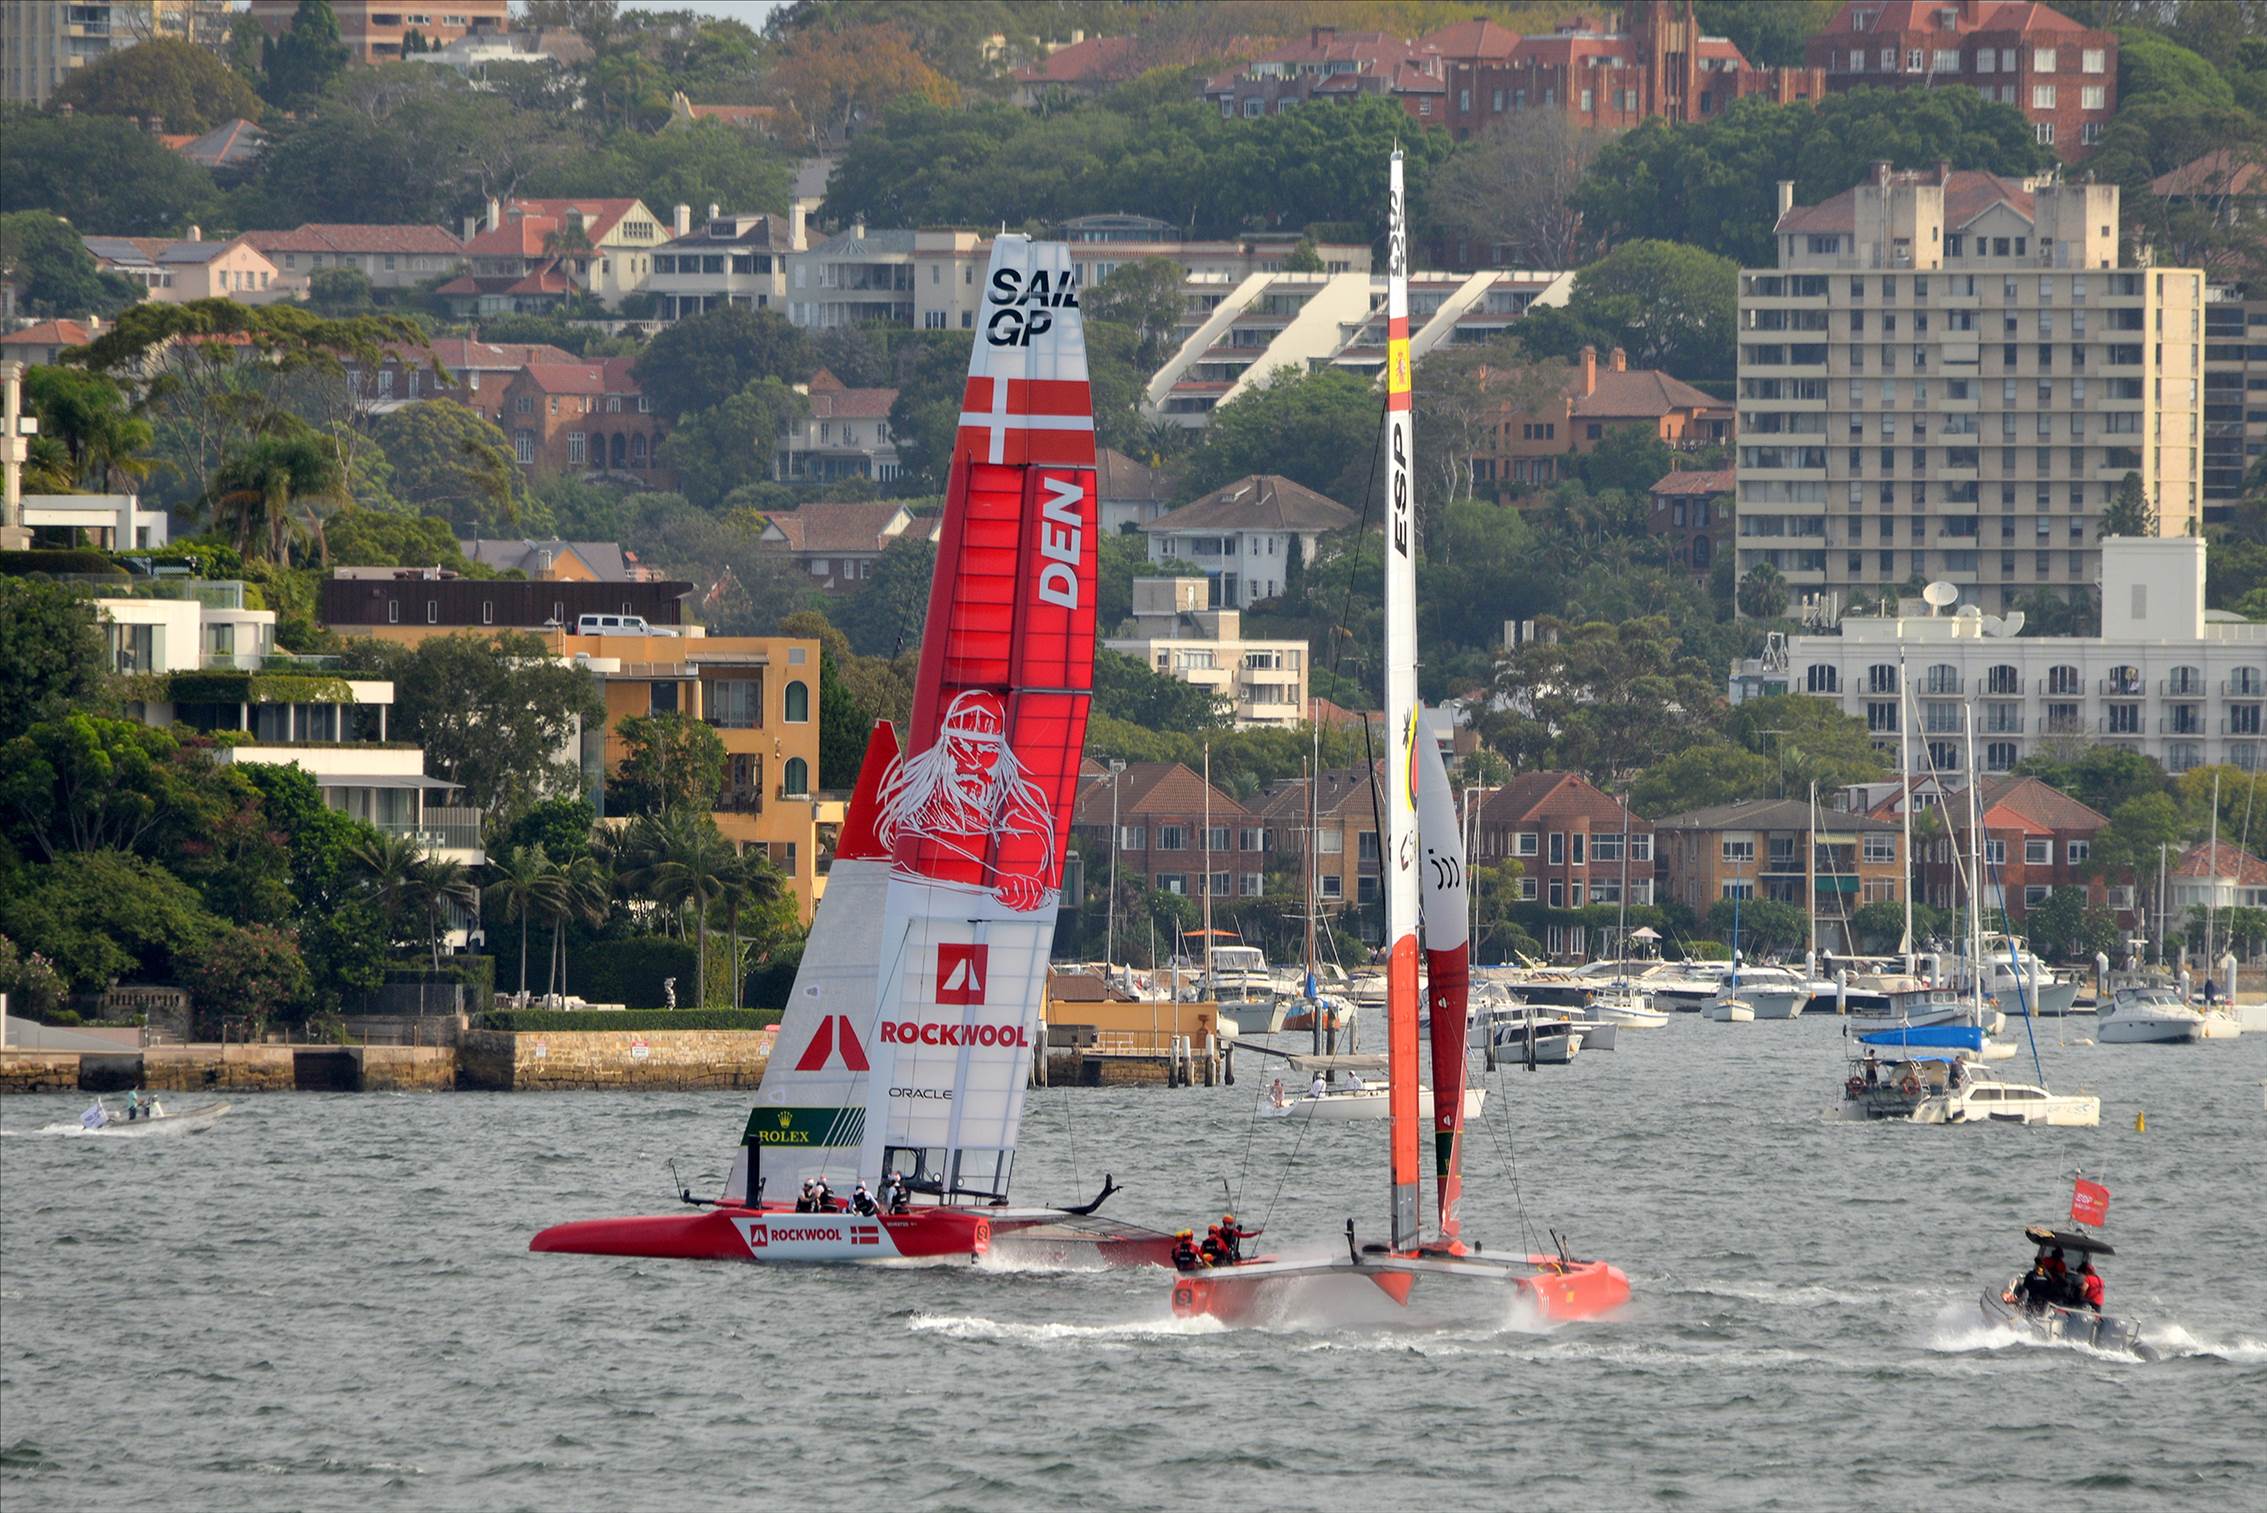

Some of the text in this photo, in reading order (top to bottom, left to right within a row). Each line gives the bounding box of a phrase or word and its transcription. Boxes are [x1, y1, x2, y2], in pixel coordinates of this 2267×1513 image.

[987, 267, 1079, 308] SAIL
[986, 308, 1053, 347] GP
[1393, 422, 1408, 560] ESP
[1039, 476, 1084, 610] DEN
[880, 1020, 1028, 1048] ROCKWOOL
[888, 1087, 953, 1100] ORACLE
[759, 1130, 809, 1143] ROLEX
[771, 1228, 842, 1241] ROCKWOOL
